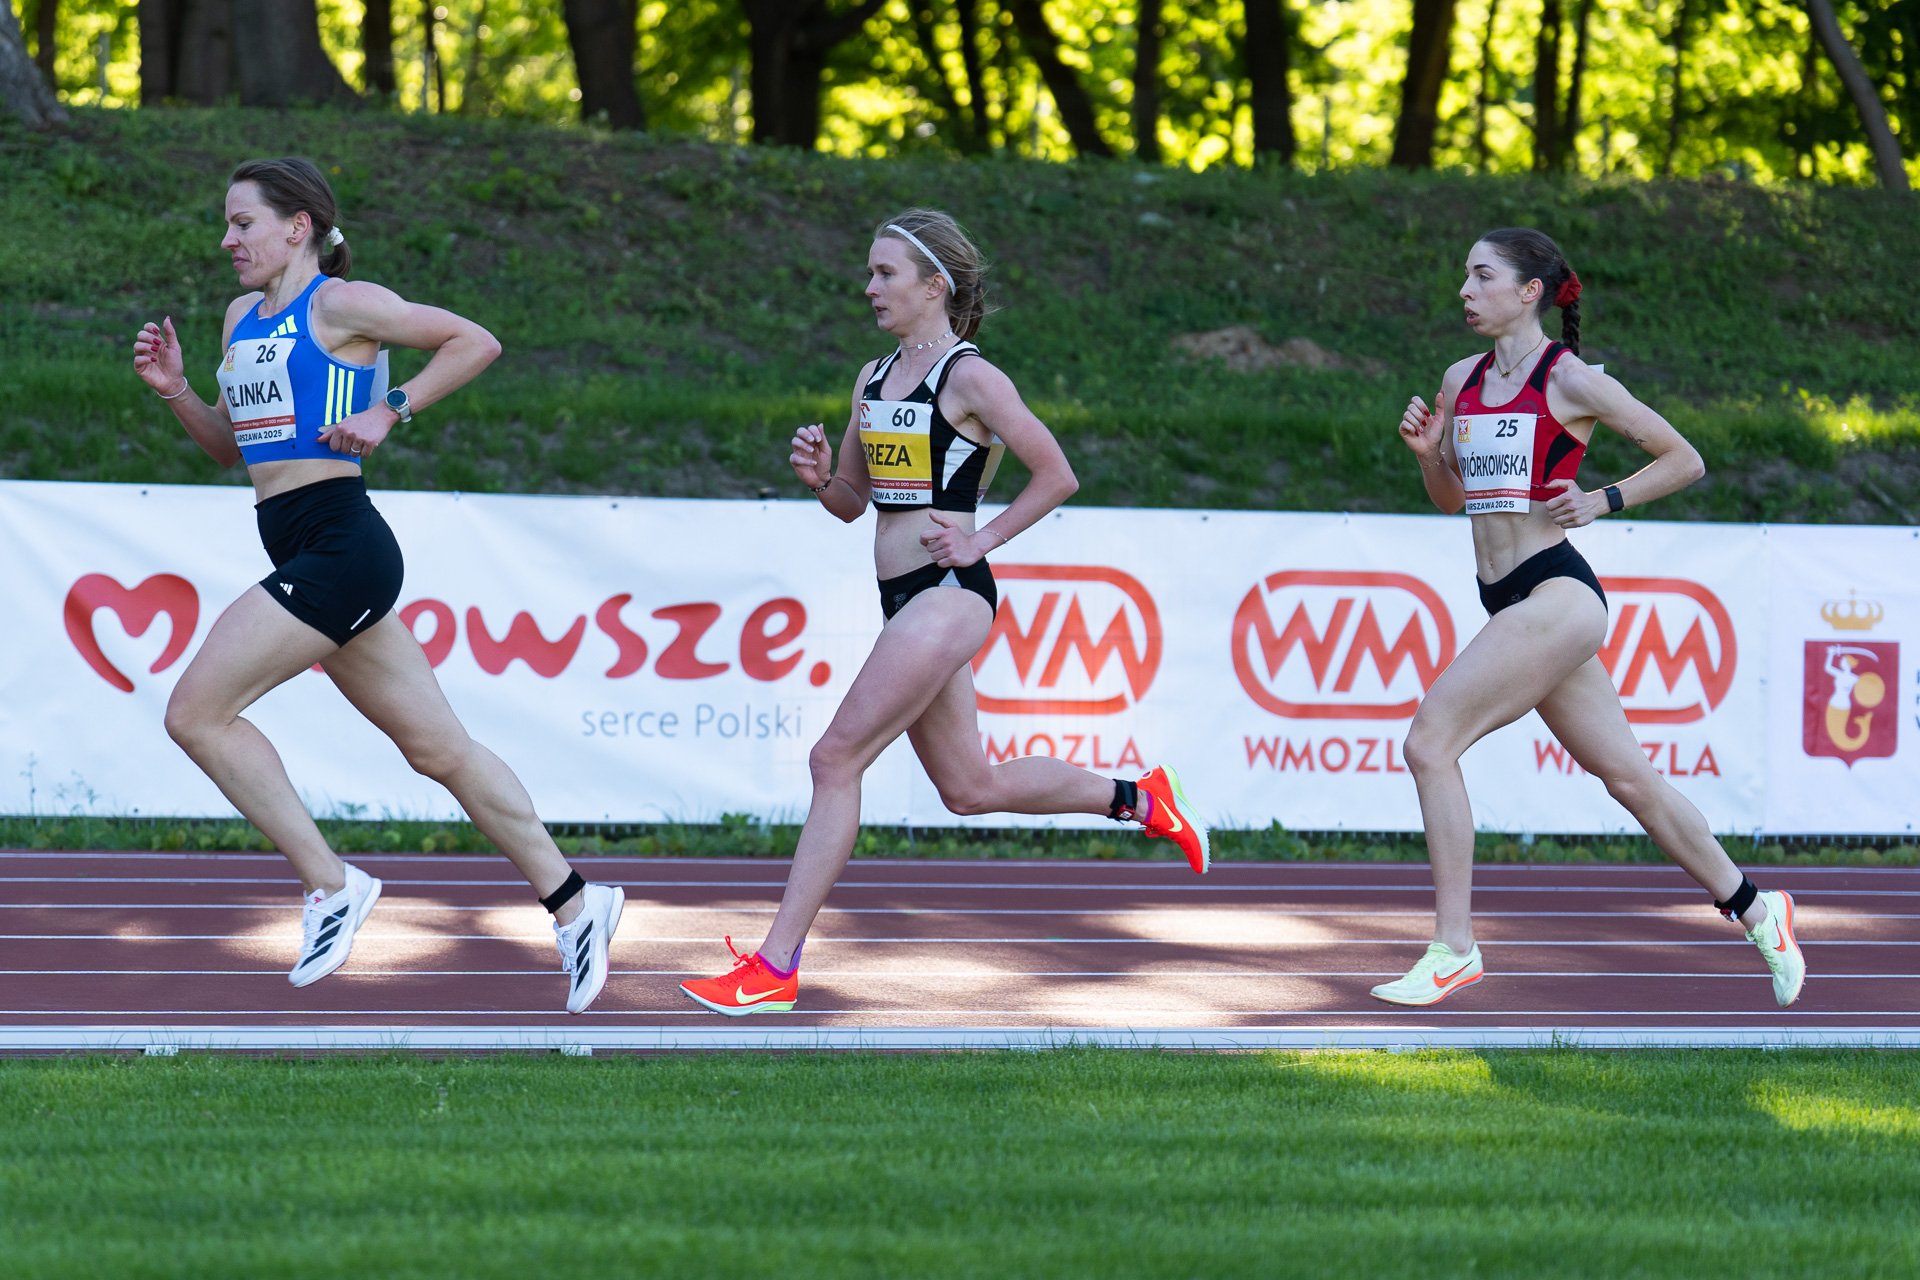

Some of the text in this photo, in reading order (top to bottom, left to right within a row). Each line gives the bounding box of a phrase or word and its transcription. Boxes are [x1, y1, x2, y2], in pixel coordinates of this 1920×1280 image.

[256, 344, 277, 364] 26
[892, 408, 916, 428] 60
[263, 429, 282, 439] 2025
[1495, 419, 1519, 438] 25
[893, 492, 917, 501] 2025
[1495, 500, 1515, 509] 2025
[582, 703, 802, 739] serce Polski
[978, 732, 1145, 769] MOZLA
[1244, 736, 1411, 773] WMOZL
[1534, 739, 1721, 777] WZLA
